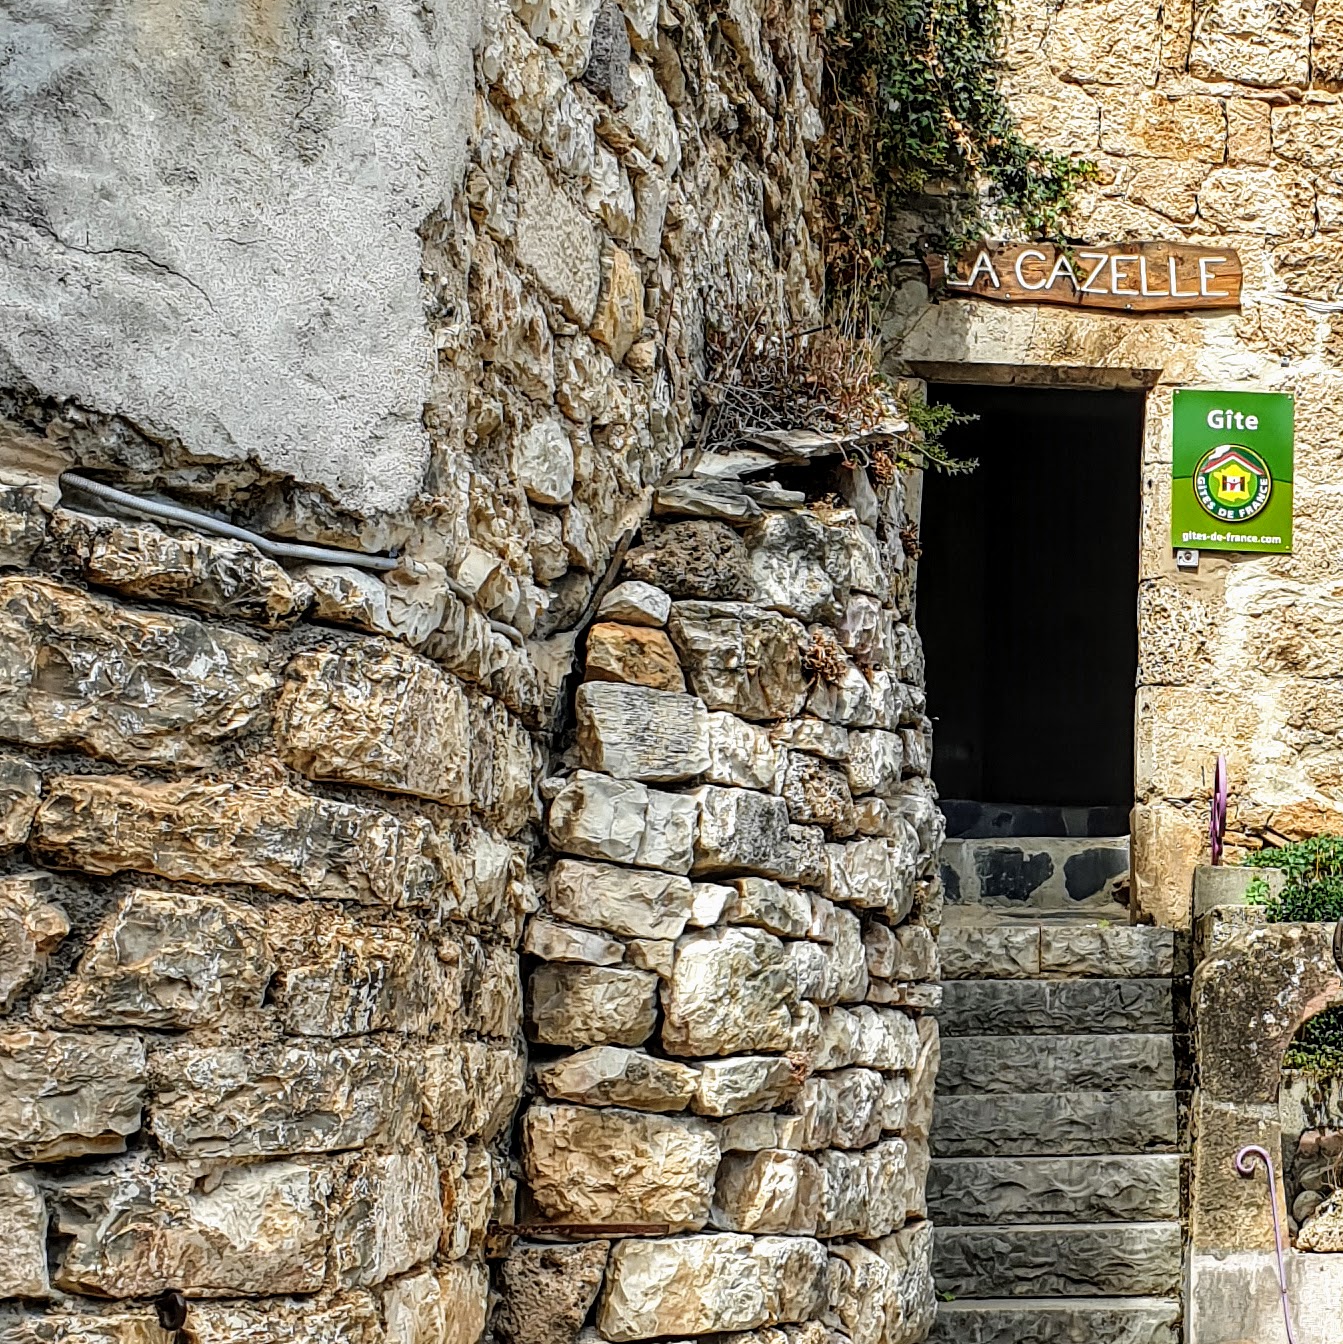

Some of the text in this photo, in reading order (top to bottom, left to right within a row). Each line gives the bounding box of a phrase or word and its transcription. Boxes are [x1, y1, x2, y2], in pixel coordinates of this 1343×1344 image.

[942, 249, 1229, 297] LA CAZELLE
[1207, 409, 1259, 430] Gîte
[1218, 507, 1235, 519] DE
[1239, 477, 1268, 518] FRANCE
